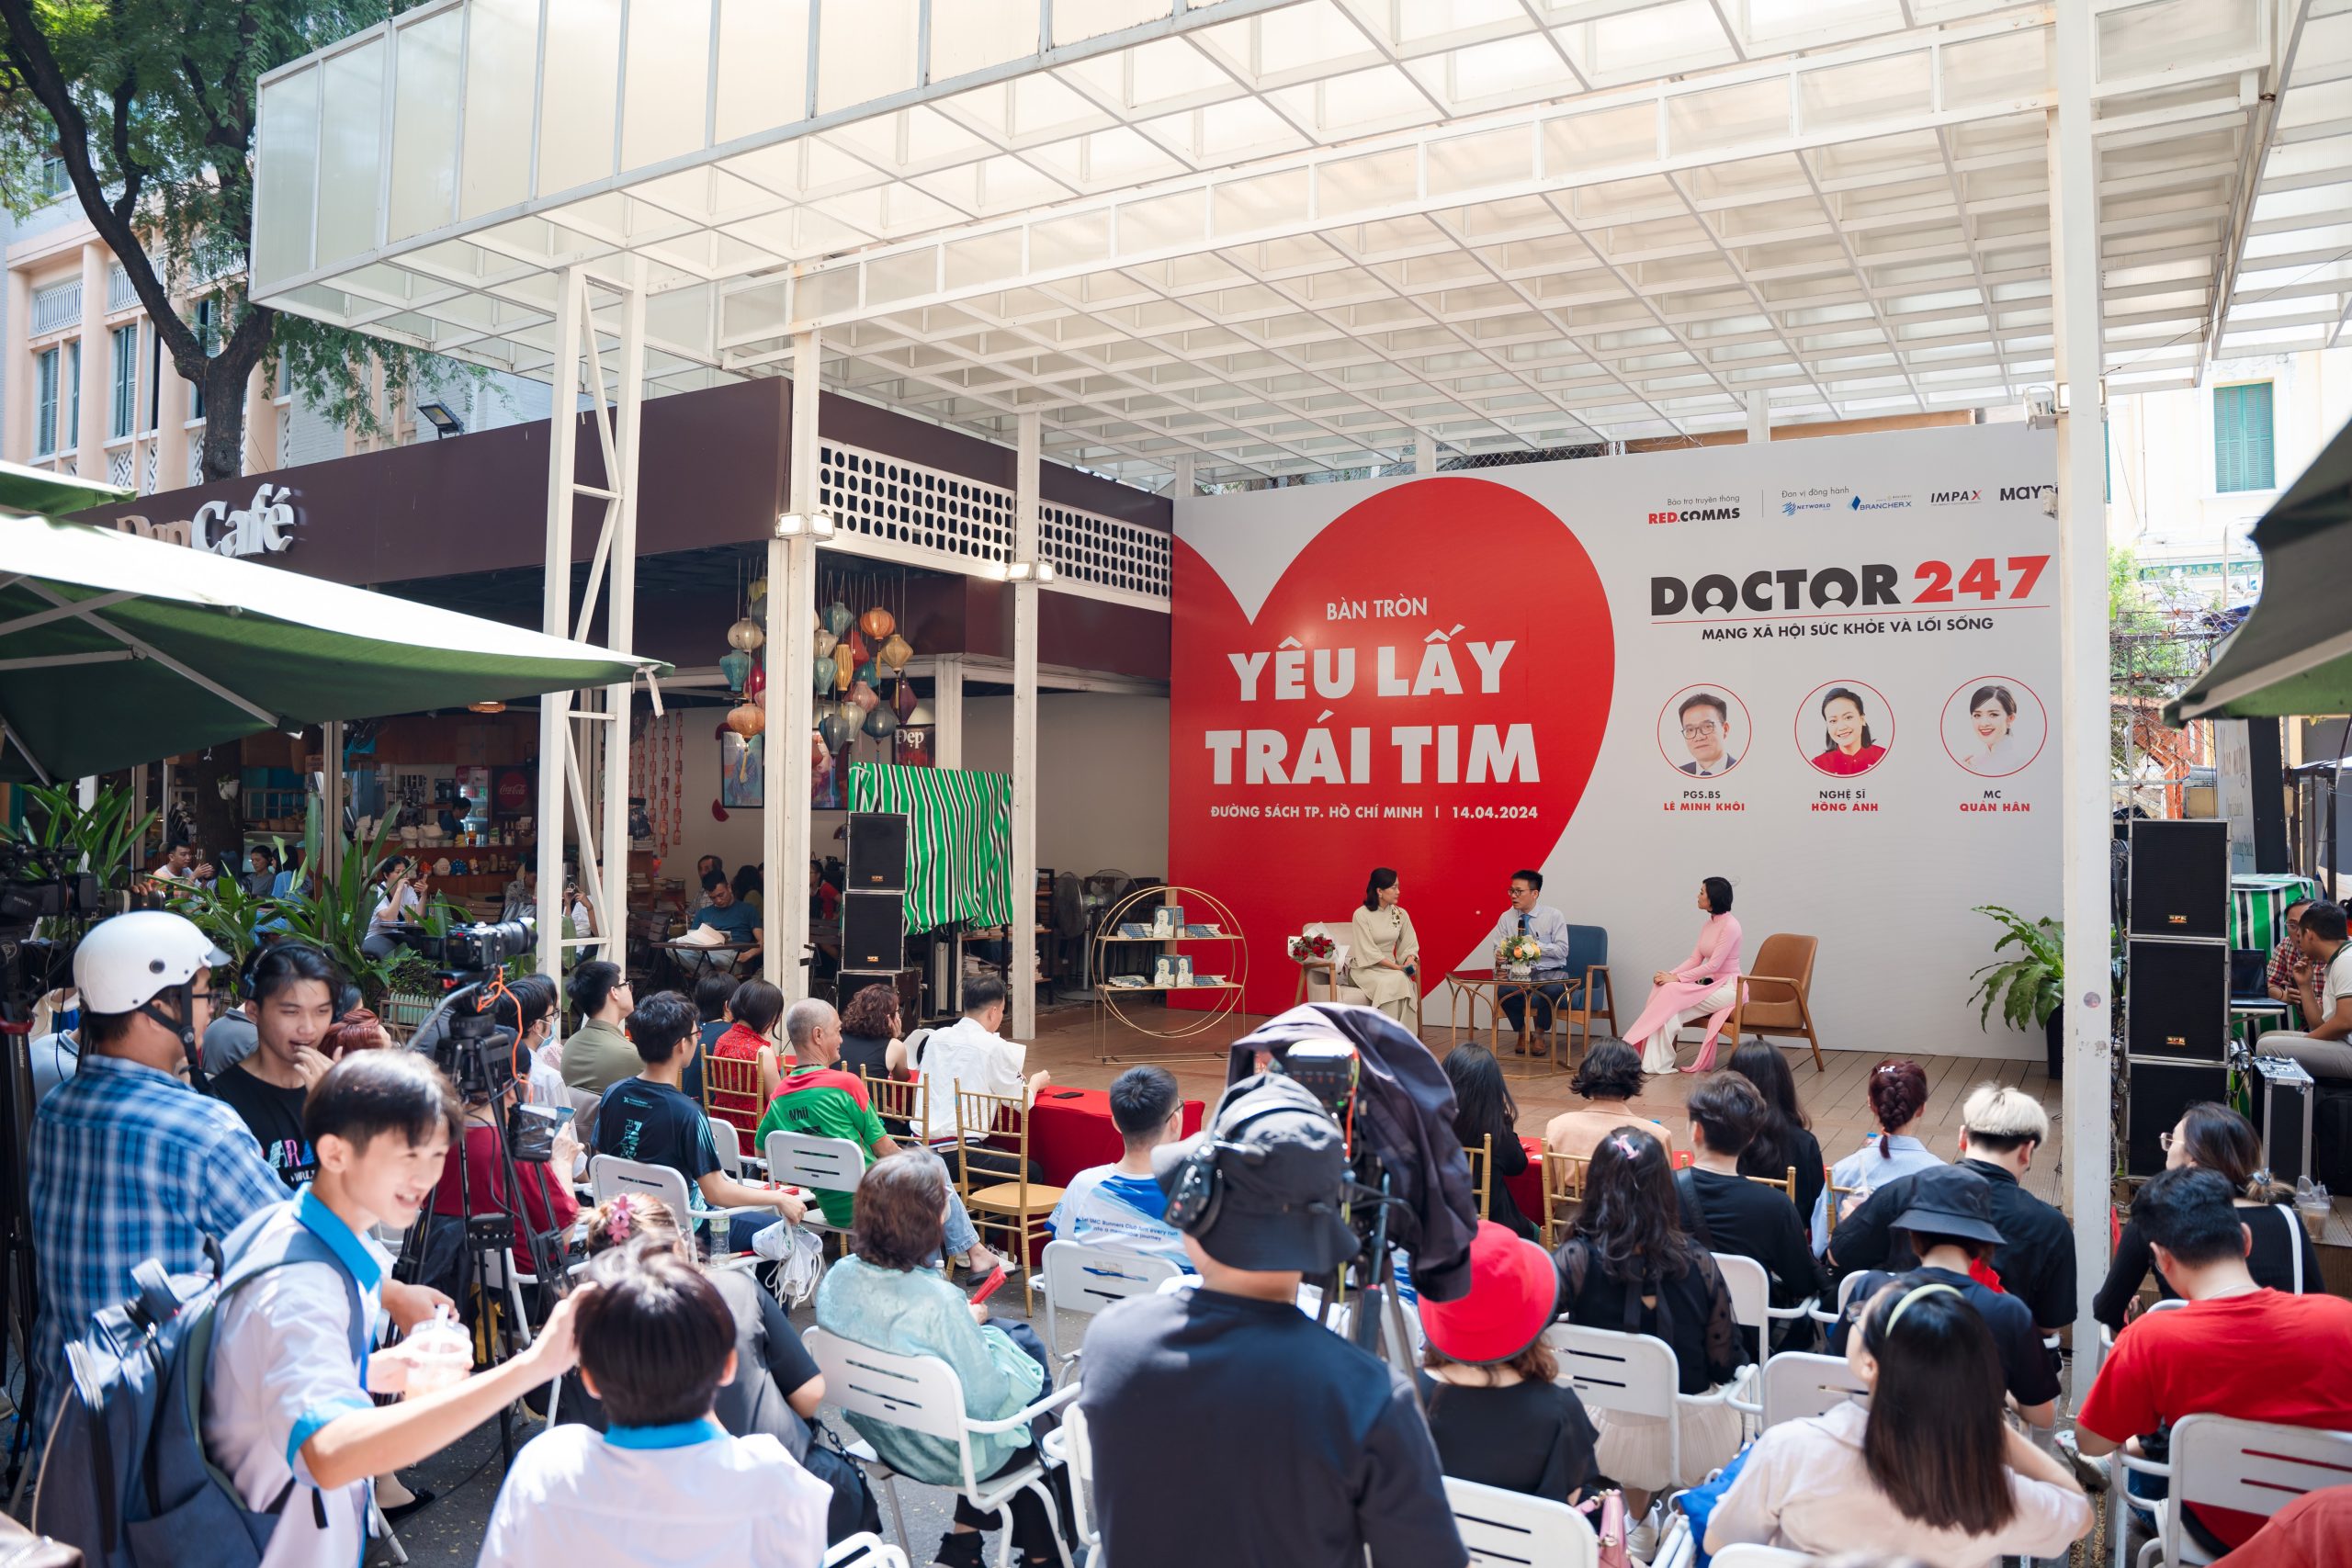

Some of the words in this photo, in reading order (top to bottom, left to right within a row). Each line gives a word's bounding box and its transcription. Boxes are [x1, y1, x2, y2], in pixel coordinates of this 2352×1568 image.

[1930, 490, 1983, 502] IMPAX
[1651, 564, 1901, 615] DOCTOR
[1911, 555, 2051, 604] 247
[1327, 596, 1366, 620] BÀN
[1374, 592, 1428, 618] TRÒN
[1702, 628, 1747, 641] MẠNG
[1753, 624, 1773, 638] XÃ
[1779, 623, 1805, 639] HỘI
[1810, 621, 1838, 636] SỨC
[1843, 618, 1885, 635] KHỎE
[1890, 618, 1912, 633] VÀ
[1917, 616, 1941, 631] LỐI
[1947, 615, 1994, 631] SỐNG
[1227, 636, 1355, 701] YÊU
[1377, 623, 1516, 697] LẤY
[895, 728, 924, 749] Đẹp
[1205, 709, 1371, 784] TRÁI
[1391, 723, 1541, 784] TIM
[1683, 790, 1721, 799] PGS.BS
[1819, 788, 1851, 801] NGHỆ
[1855, 788, 1866, 799] SĨ
[1984, 790, 2001, 799] MC
[1210, 803, 1260, 818] ĐƯỜNG
[1264, 803, 1299, 818] SÁCH
[1305, 806, 1324, 818] TP.
[1329, 802, 1351, 818] HỒ
[1355, 804, 1379, 818] CHÍ
[1384, 806, 1423, 818] MINH
[1453, 806, 1539, 819] 14.04.2024
[1664, 800, 1676, 811] LÊ
[1679, 803, 1711, 811] MINH
[1715, 800, 1745, 811] KHÔI
[1811, 800, 1848, 811] HỒNG
[2002, 801, 2030, 812] HÂN
[1102, 1220, 1125, 1228] Runners
[1139, 1234, 1161, 1242] journey
